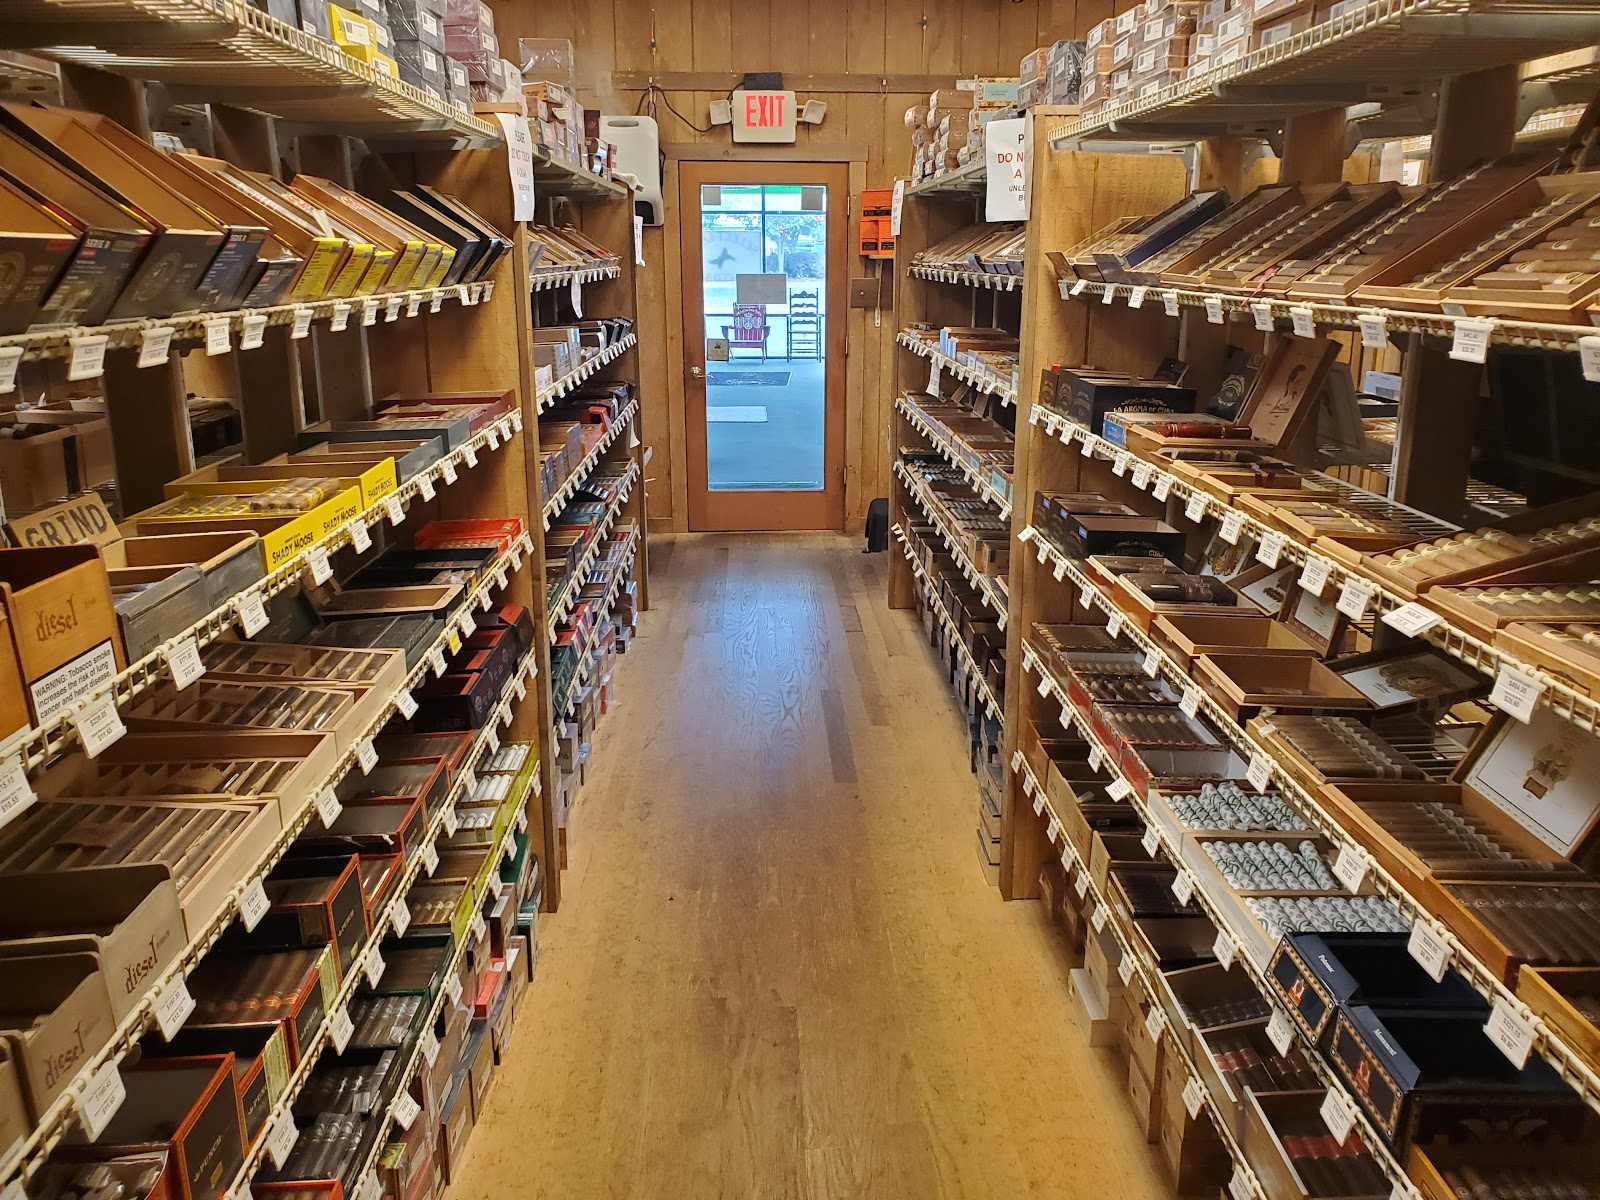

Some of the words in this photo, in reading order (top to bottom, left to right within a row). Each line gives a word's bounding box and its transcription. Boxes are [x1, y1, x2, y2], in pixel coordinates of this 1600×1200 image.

[746, 96, 785, 127] EXIT
[998, 153, 1013, 163] DO
[85, 238, 104, 248] SERIE
[1124, 405, 1147, 413] AROMA
[368, 488, 379, 500] SHADY
[380, 478, 392, 492] MOOSE
[24, 503, 108, 548] GRIND
[323, 517, 340, 533] SHADY
[340, 505, 357, 520] MOOSE
[273, 546, 292, 564] SHADY
[294, 532, 314, 548] MOOSE
[35, 593, 78, 642] diesel
[35, 674, 68, 698] WARNING:
[68, 660, 92, 678] Tobacco
[93, 649, 111, 664] smoke
[37, 687, 67, 708] increases
[67, 680, 78, 692] the
[78, 672, 89, 684] risk
[90, 668, 96, 677] of
[96, 661, 109, 673] lung
[40, 702, 61, 719] cancer
[62, 694, 73, 706] and
[74, 686, 89, 698] heart
[124, 933, 158, 994] diesel
